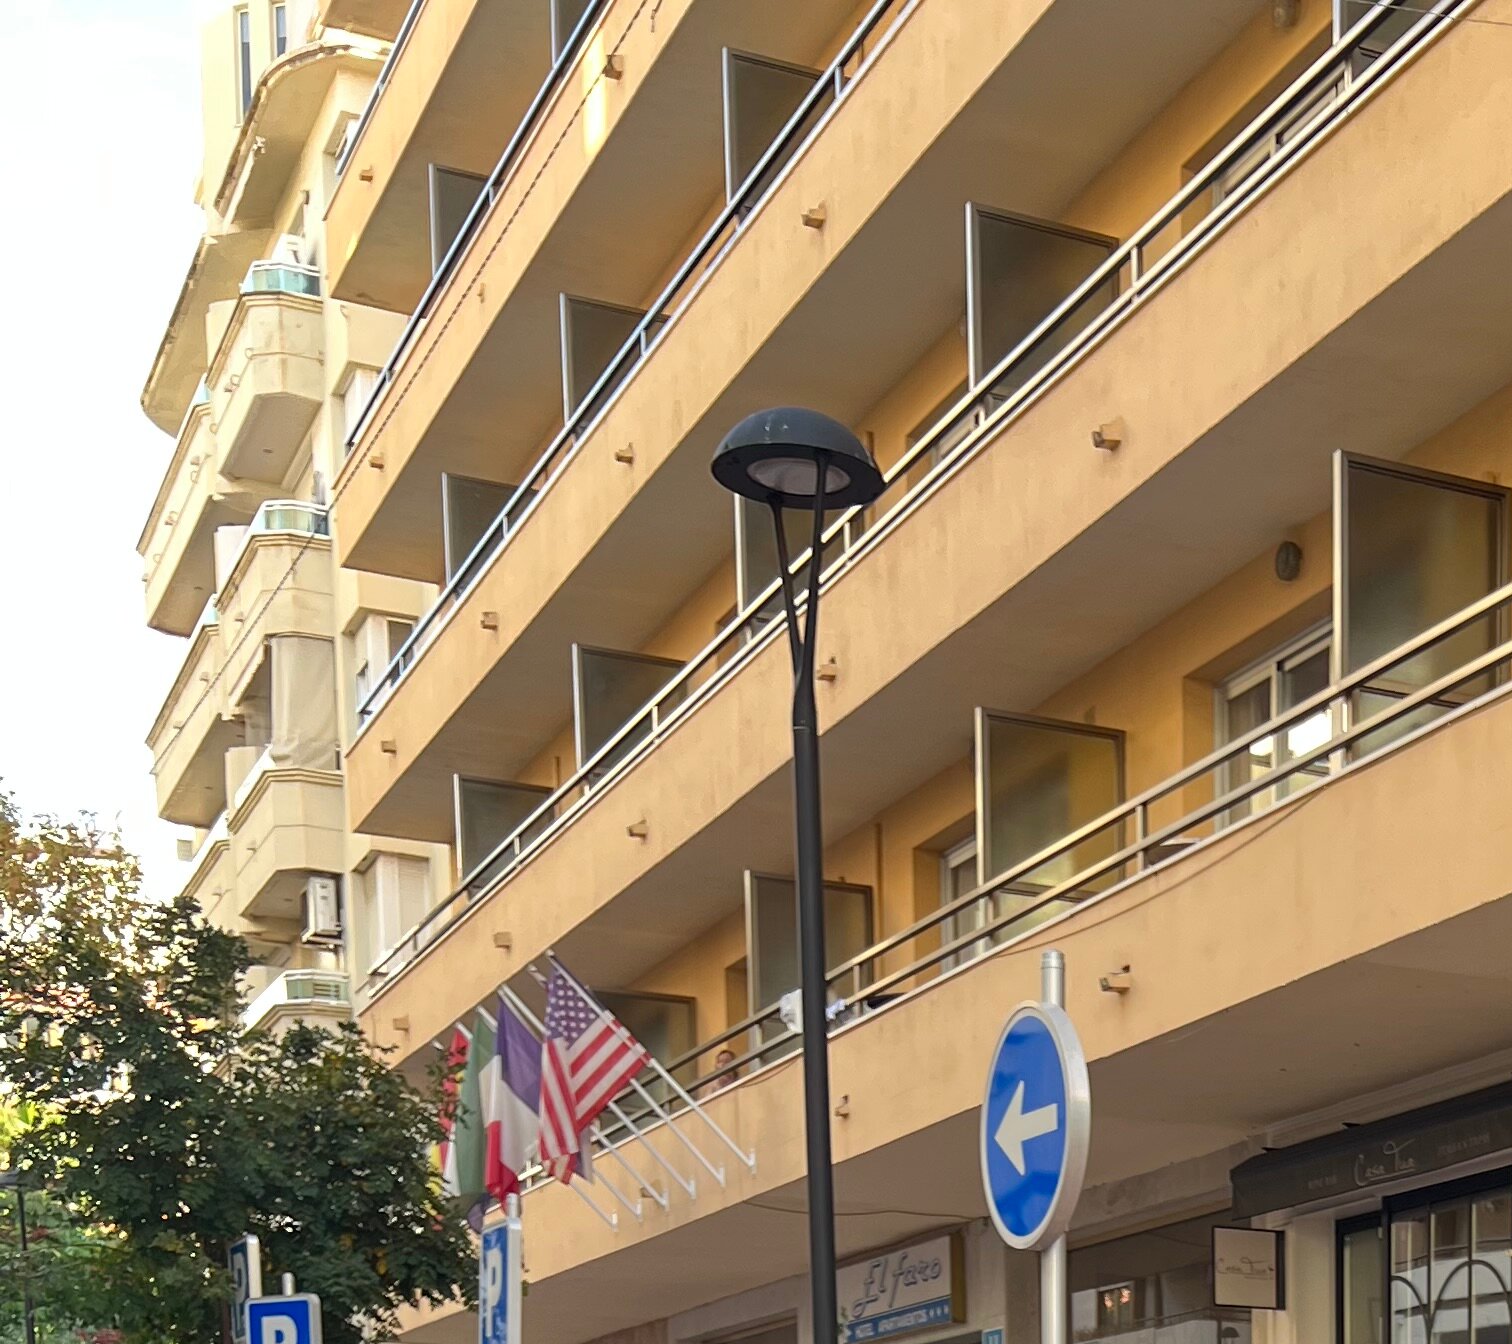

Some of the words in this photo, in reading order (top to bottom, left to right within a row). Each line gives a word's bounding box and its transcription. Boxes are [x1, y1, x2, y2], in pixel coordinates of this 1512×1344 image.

[484, 1249, 504, 1338] P
[852, 1257, 889, 1320] El
[888, 1252, 942, 1308] faro
